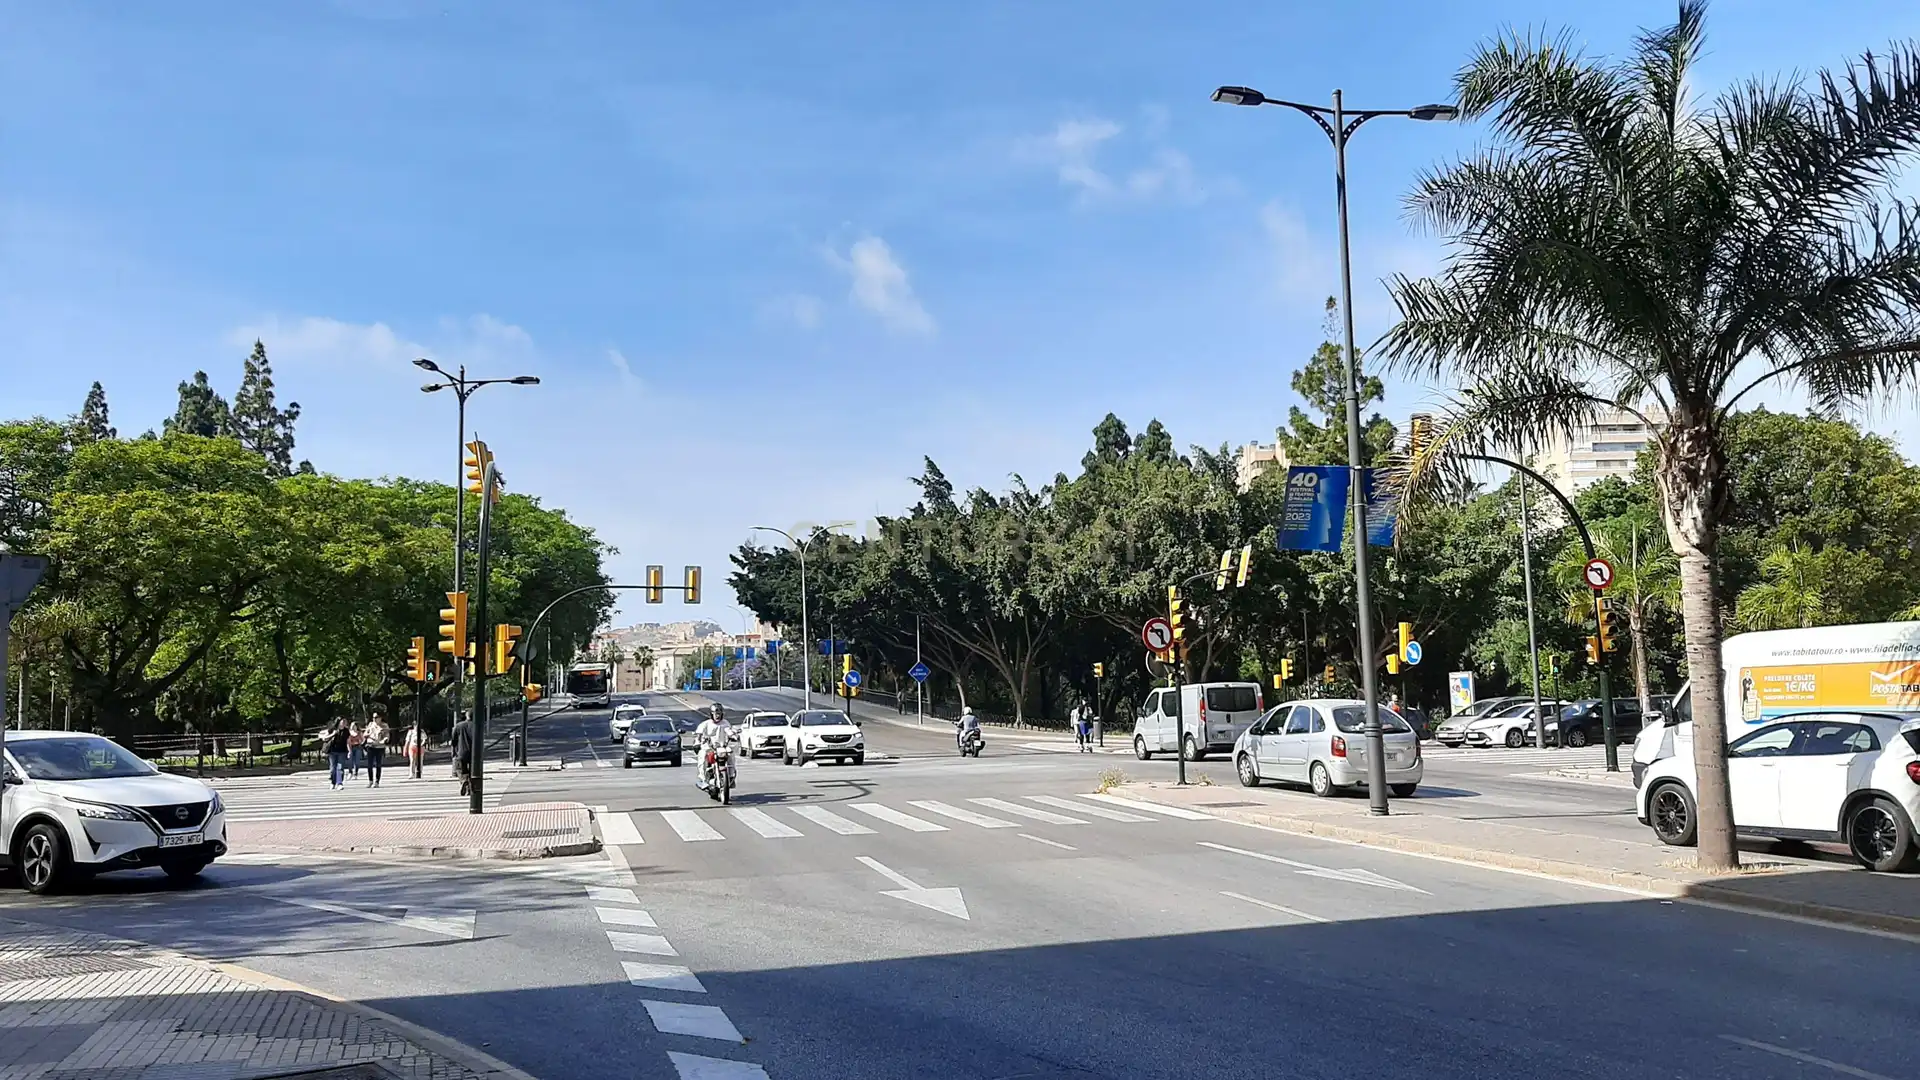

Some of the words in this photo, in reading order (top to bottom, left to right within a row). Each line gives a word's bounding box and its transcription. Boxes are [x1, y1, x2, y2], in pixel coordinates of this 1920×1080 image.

[1290, 472, 1318, 487] 40
[1285, 512, 1311, 521] 2023
[1771, 647, 1843, 657] www.tabitatour.ro
[165, 836, 184, 846] 7325
